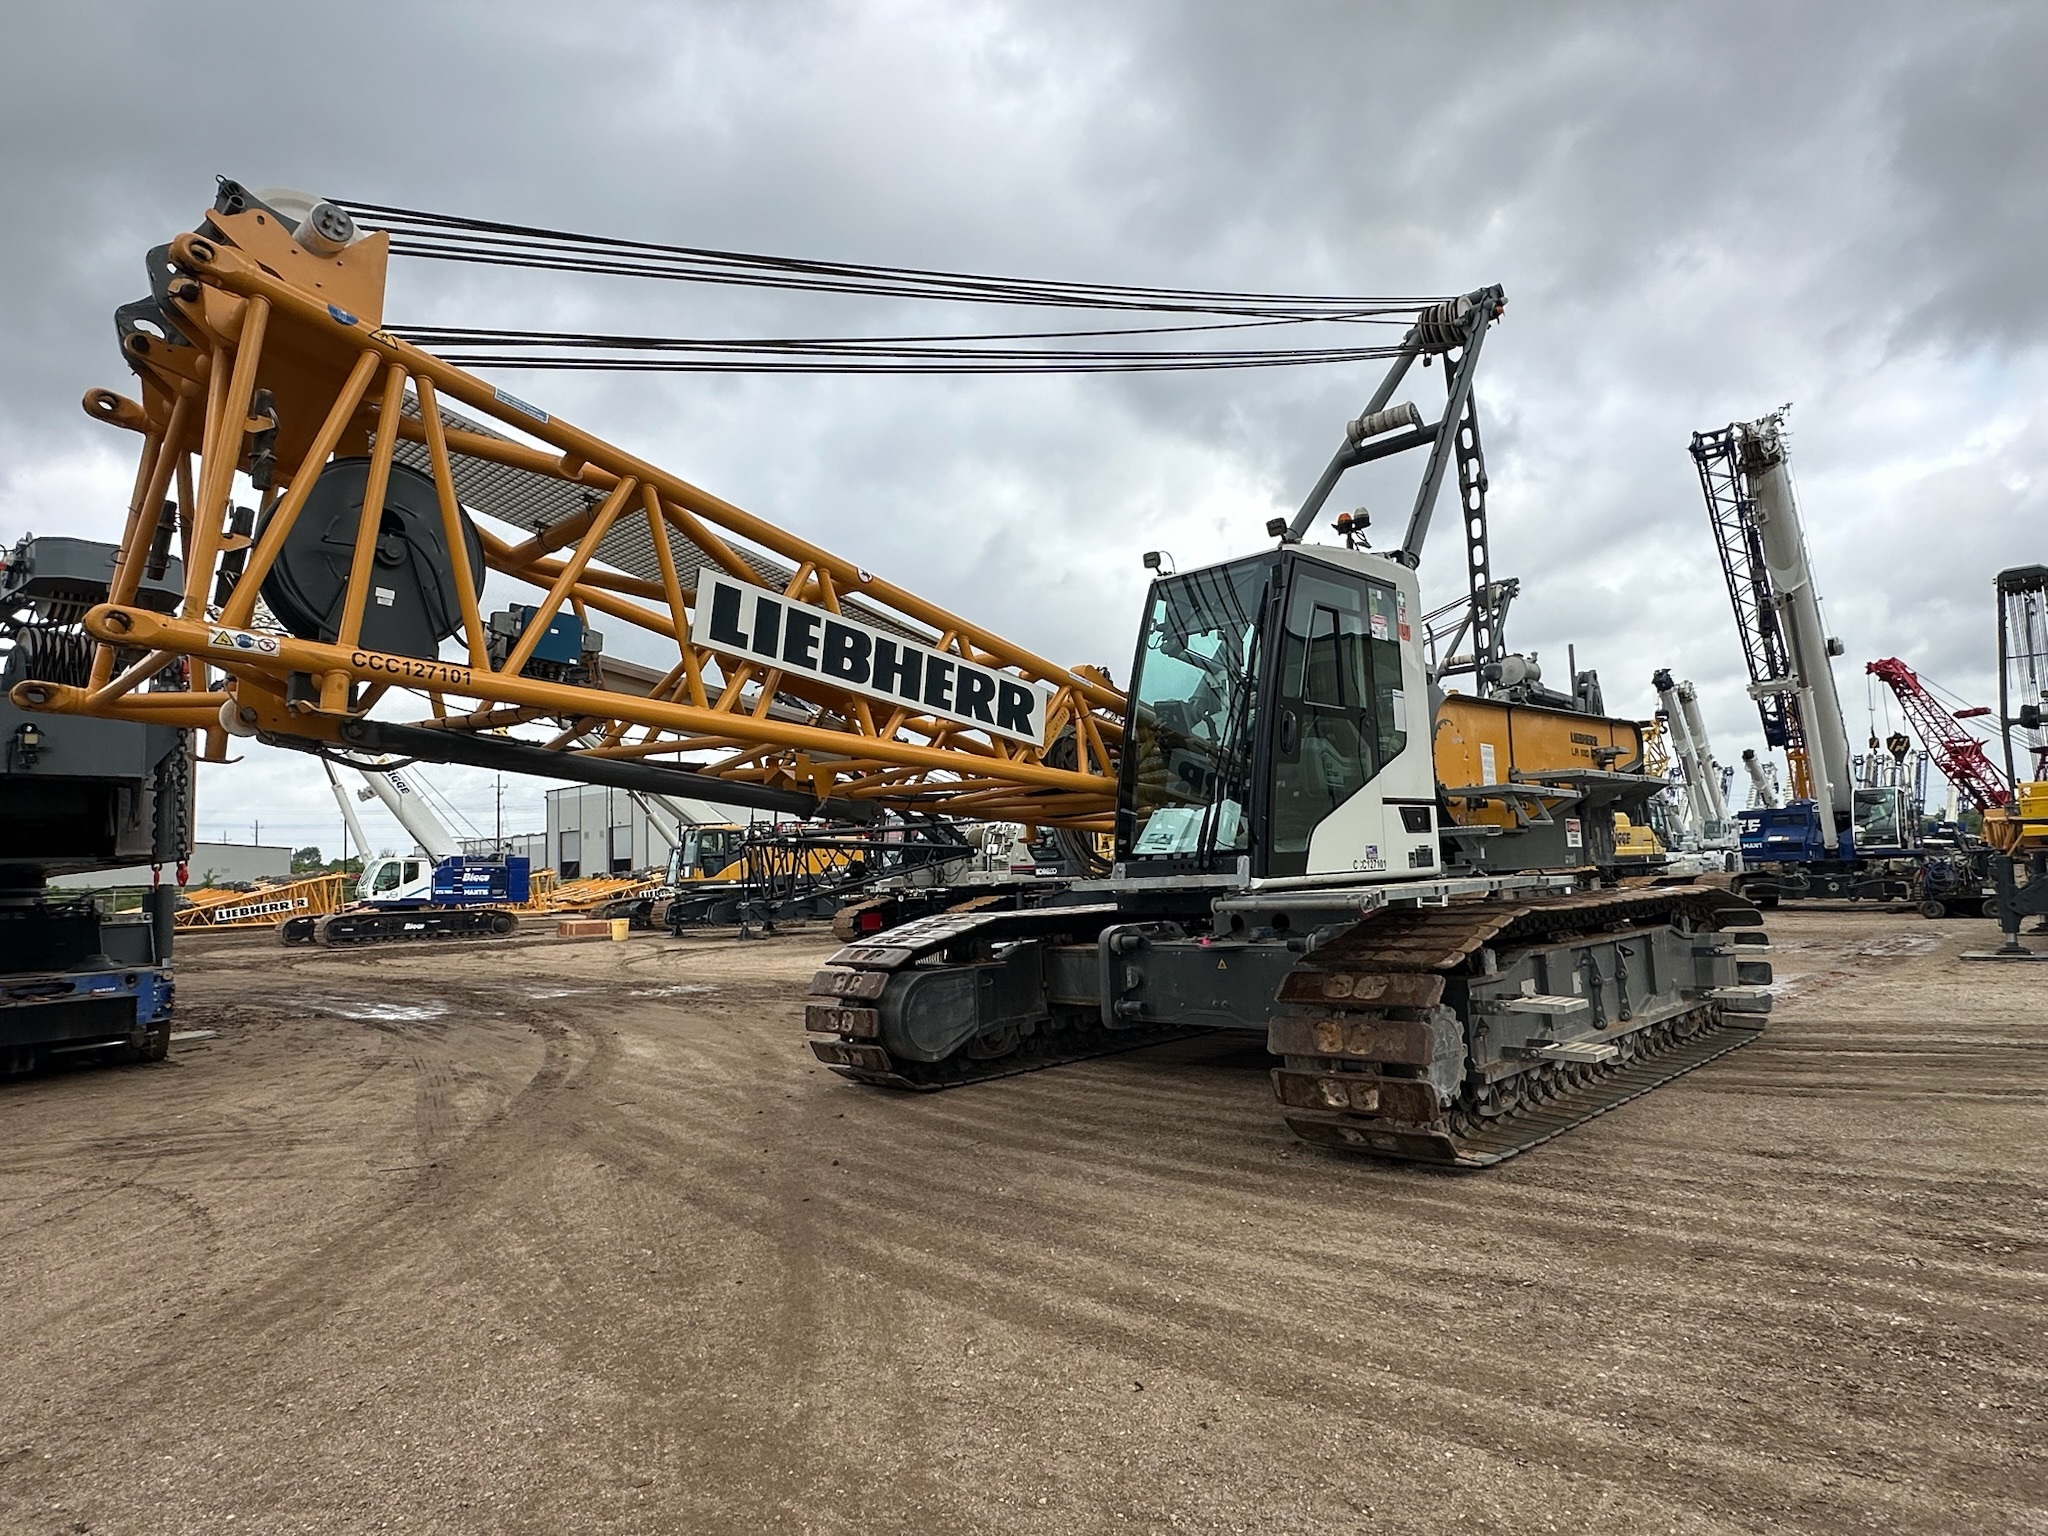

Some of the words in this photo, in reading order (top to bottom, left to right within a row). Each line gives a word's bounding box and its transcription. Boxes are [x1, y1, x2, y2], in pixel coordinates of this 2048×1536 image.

[351, 652, 471, 685] CCC127101
[709, 581, 1035, 737] LIEBHERR
[218, 901, 290, 919] LIEBHERR
